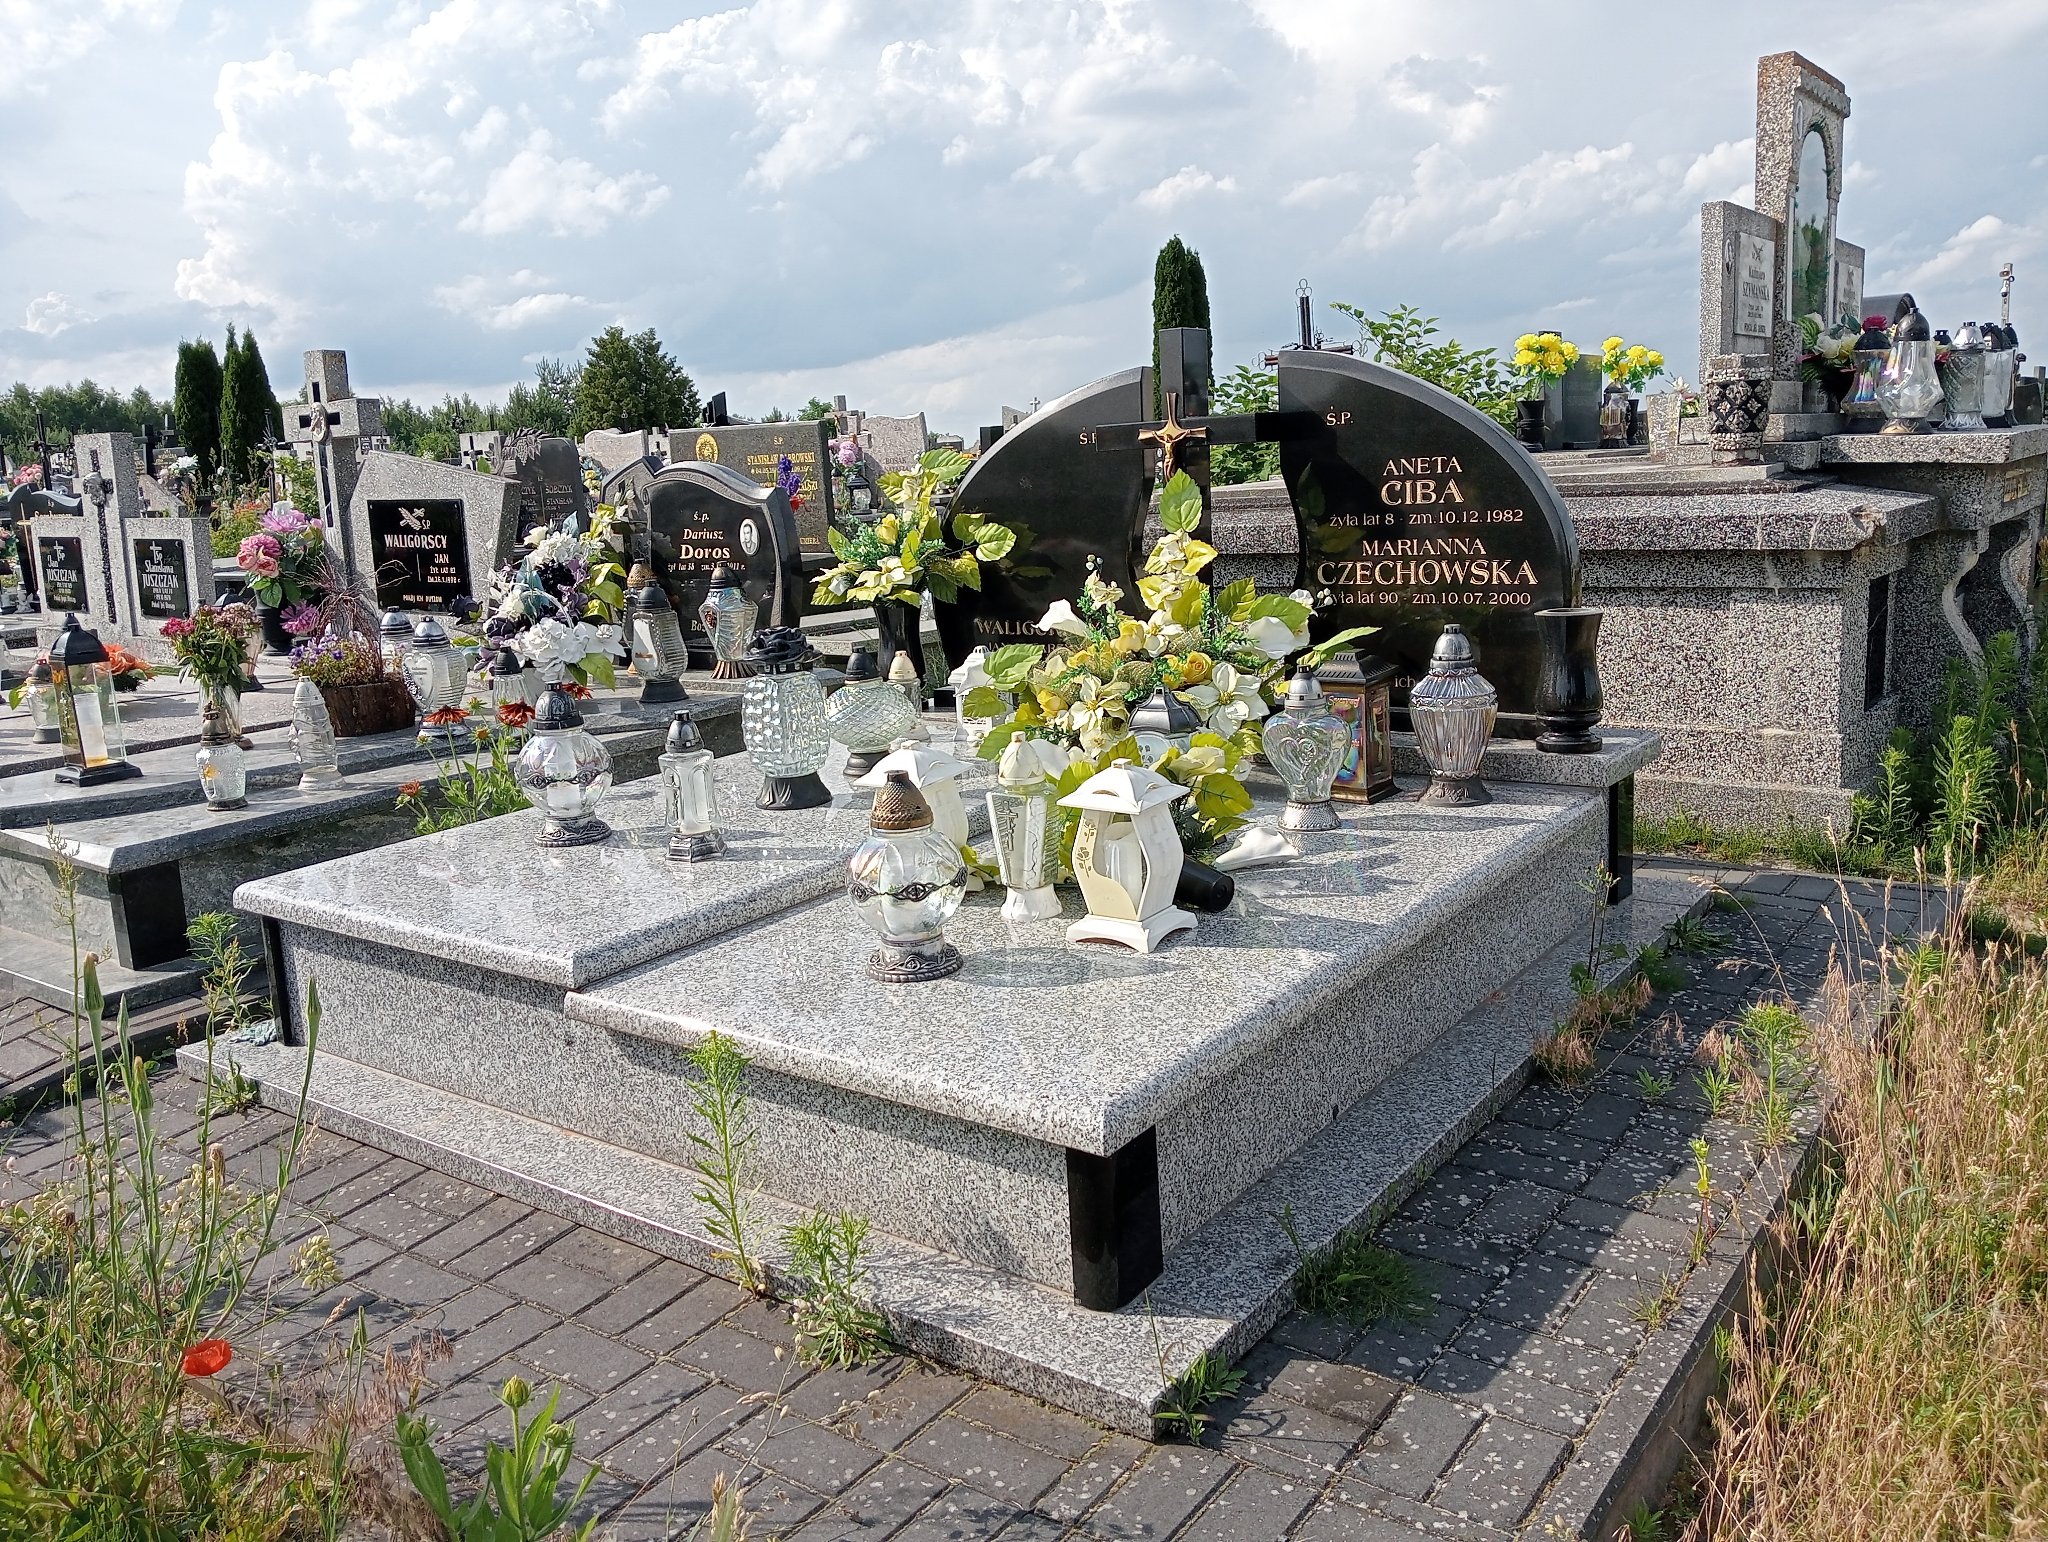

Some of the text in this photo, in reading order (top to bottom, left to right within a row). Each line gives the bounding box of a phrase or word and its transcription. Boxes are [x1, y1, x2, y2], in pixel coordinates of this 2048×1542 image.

[1326, 405, 1354, 426] Ś.P.
[1383, 456, 1463, 476] ANETA
[1381, 478, 1465, 506] CIBA
[1329, 513, 1359, 530] żyła
[1363, 513, 1381, 527] lat
[1385, 513, 1395, 526] 8
[384, 532, 447, 549] WALIGÓRSCY
[683, 527, 724, 540] Dariusz
[680, 544, 731, 559] Doros
[1362, 538, 1487, 556] MARIANNA
[47, 554, 59, 568] Jan
[435, 553, 449, 564] JAN
[45, 568, 78, 584] JUSZCZAK
[1317, 559, 1539, 585] CZECHOWSKA
[142, 573, 179, 589] JUSZCZAK
[1357, 590, 1375, 604] lat
[1379, 591, 1399, 604] 90
[1412, 591, 1531, 606] zm.10.07.2000
